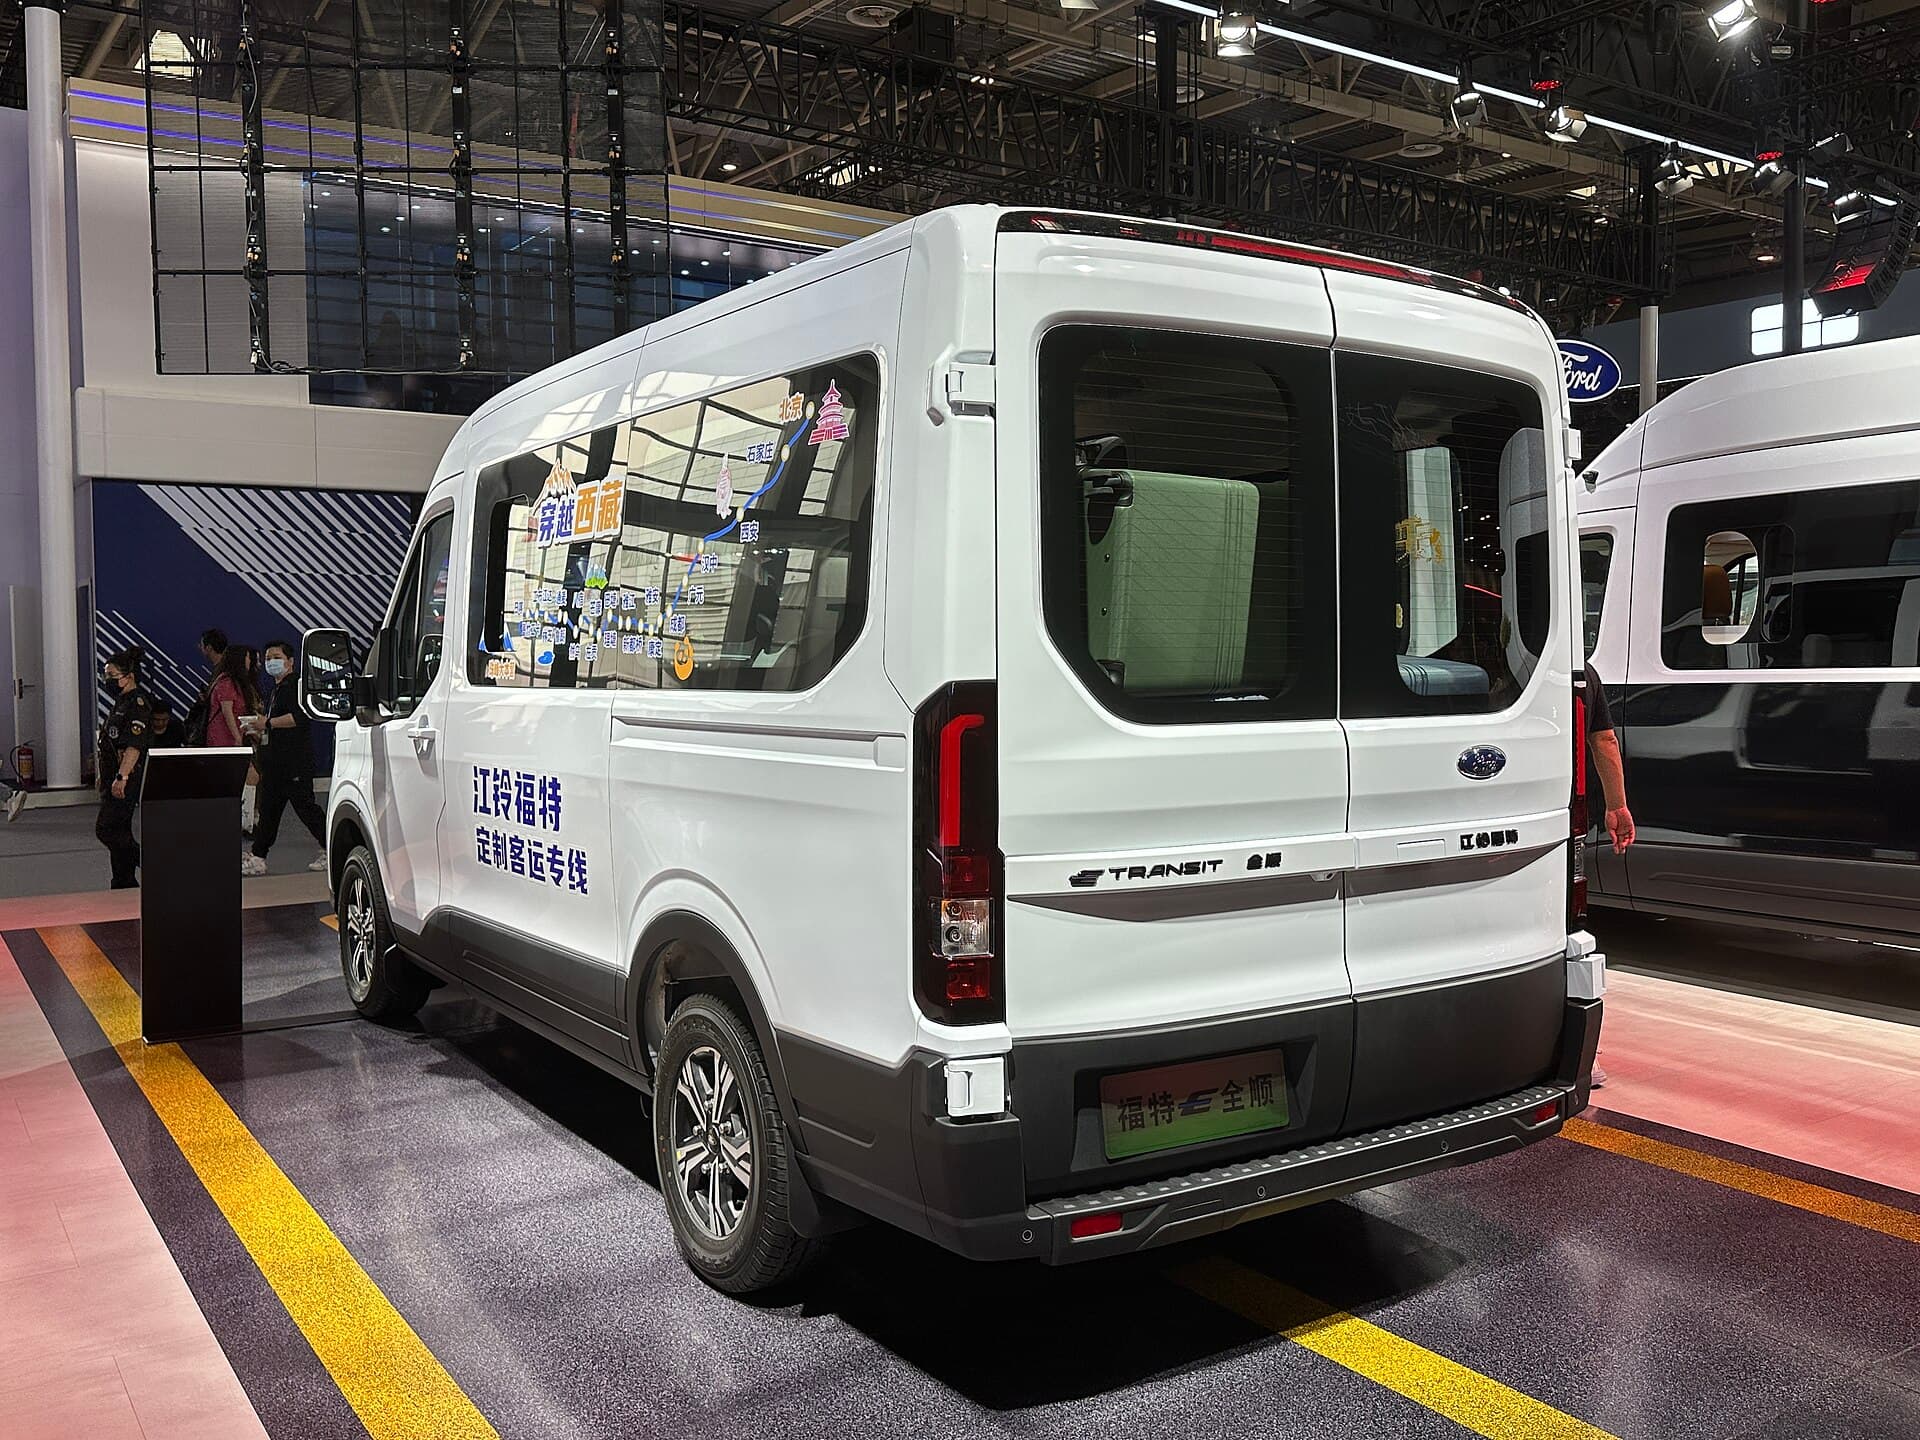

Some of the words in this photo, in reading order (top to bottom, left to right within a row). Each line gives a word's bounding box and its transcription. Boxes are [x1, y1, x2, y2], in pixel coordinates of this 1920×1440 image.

[779, 394, 803, 421] 北京
[746, 440, 774, 462] 石家庄
[538, 479, 624, 542] 穿越西藏
[741, 521, 758, 542] 西安
[702, 553, 719, 573] 汉中
[688, 585, 705, 604] 广元
[670, 615, 685, 633] 成都
[473, 765, 562, 832] 江铃福特
[476, 826, 588, 895] 定制客运专线
[1108, 859, 1223, 881] TRANSIT
